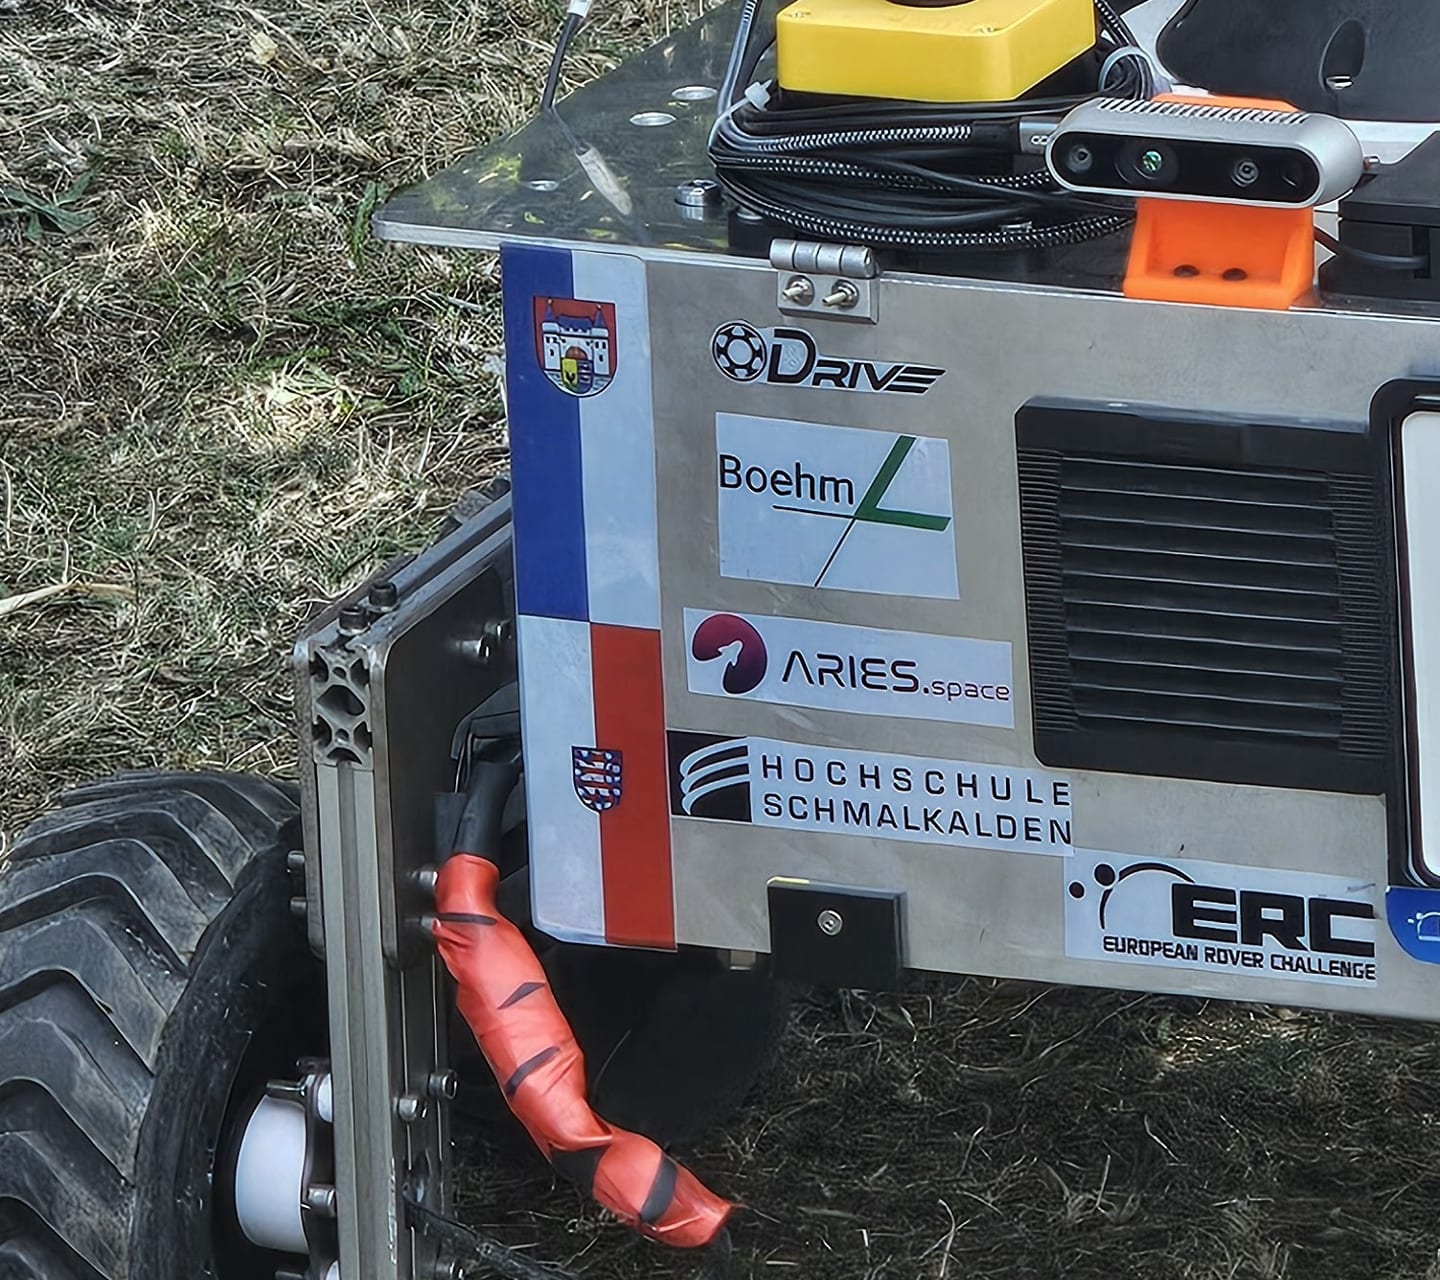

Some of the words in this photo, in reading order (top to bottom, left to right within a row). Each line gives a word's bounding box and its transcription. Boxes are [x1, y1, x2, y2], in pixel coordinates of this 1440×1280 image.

[719, 454, 855, 505] Boehm
[762, 754, 1071, 807] HOCHSCHULE
[763, 793, 1071, 844] SCHMALKALDEN
[1172, 883, 1375, 957] ERC
[1103, 936, 1198, 961] EUROPEAN
[1204, 946, 1264, 969] ROVER
[1270, 954, 1376, 980] CHALLENGE
